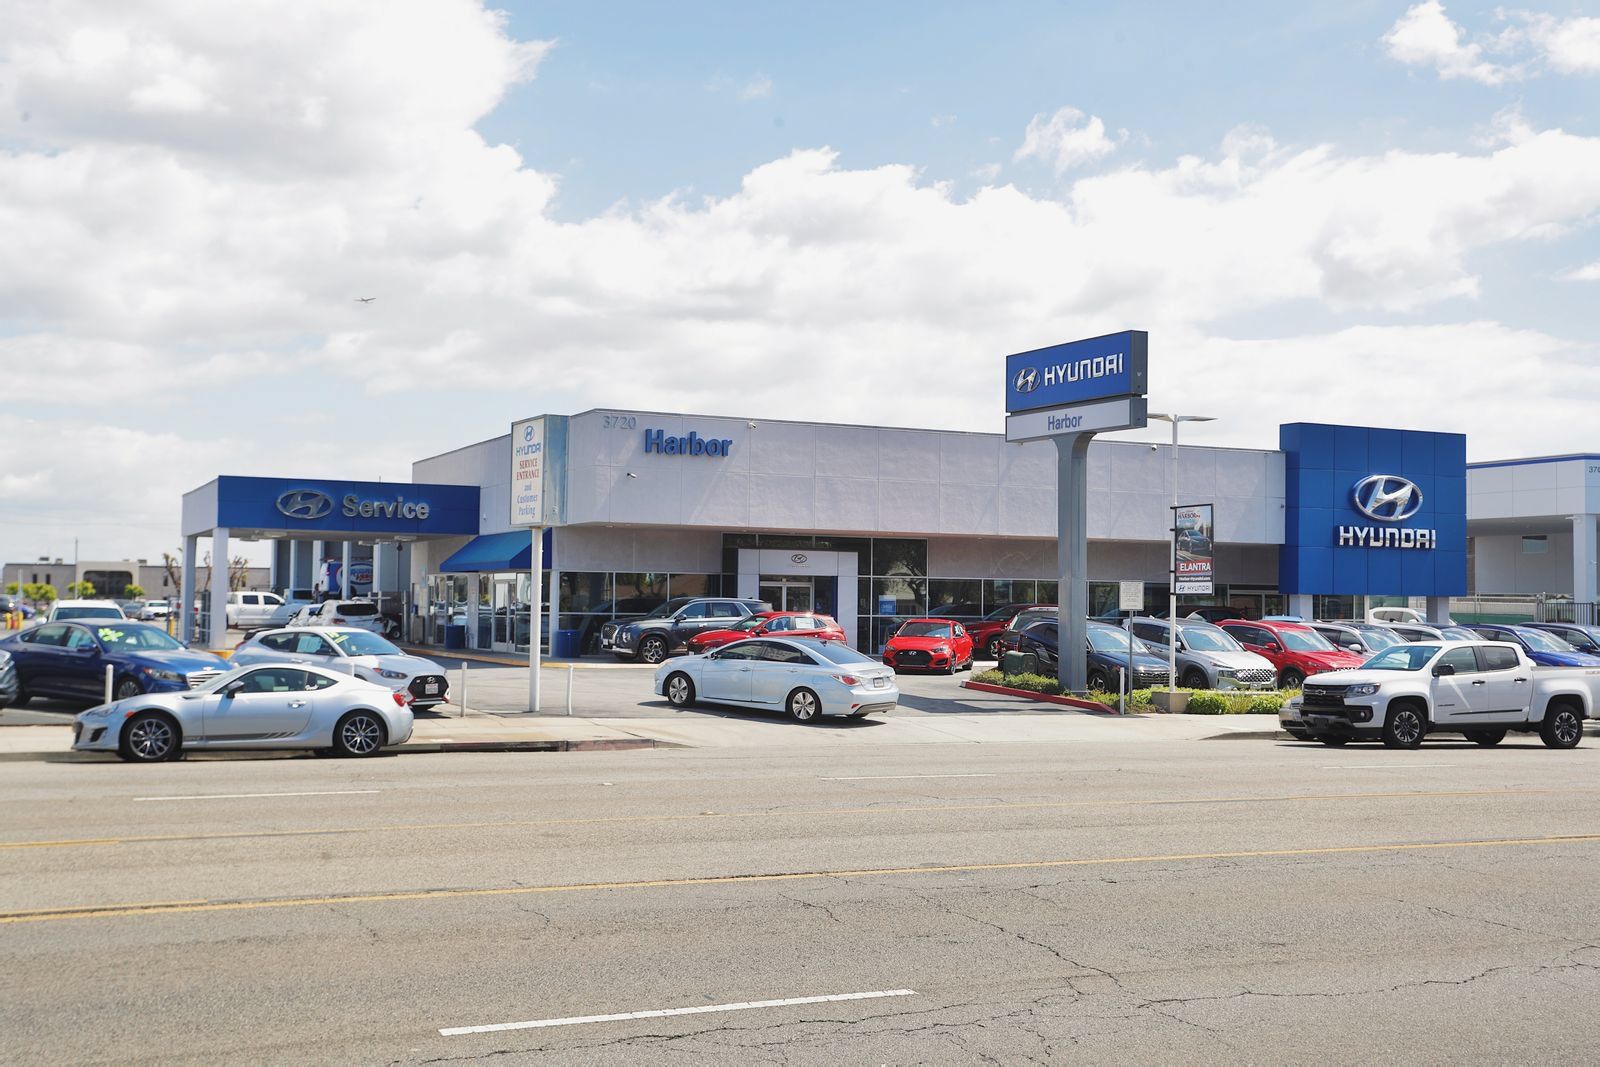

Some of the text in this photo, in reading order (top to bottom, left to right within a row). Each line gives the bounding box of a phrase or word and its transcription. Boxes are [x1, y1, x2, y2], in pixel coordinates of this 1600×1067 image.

[1044, 353, 1123, 386] HYUNDAI
[603, 415, 636, 430] 3720
[1047, 413, 1082, 431] Harbor
[516, 442, 541, 456] HYUNDAI
[644, 428, 733, 457] Harbor
[520, 458, 538, 469] SERVICE
[516, 469, 540, 480] ENTRANCE
[342, 494, 430, 519] Service
[518, 505, 535, 518] Parking
[1339, 525, 1436, 549] HYUNDAI
[1180, 562, 1211, 571] ELANTRA
